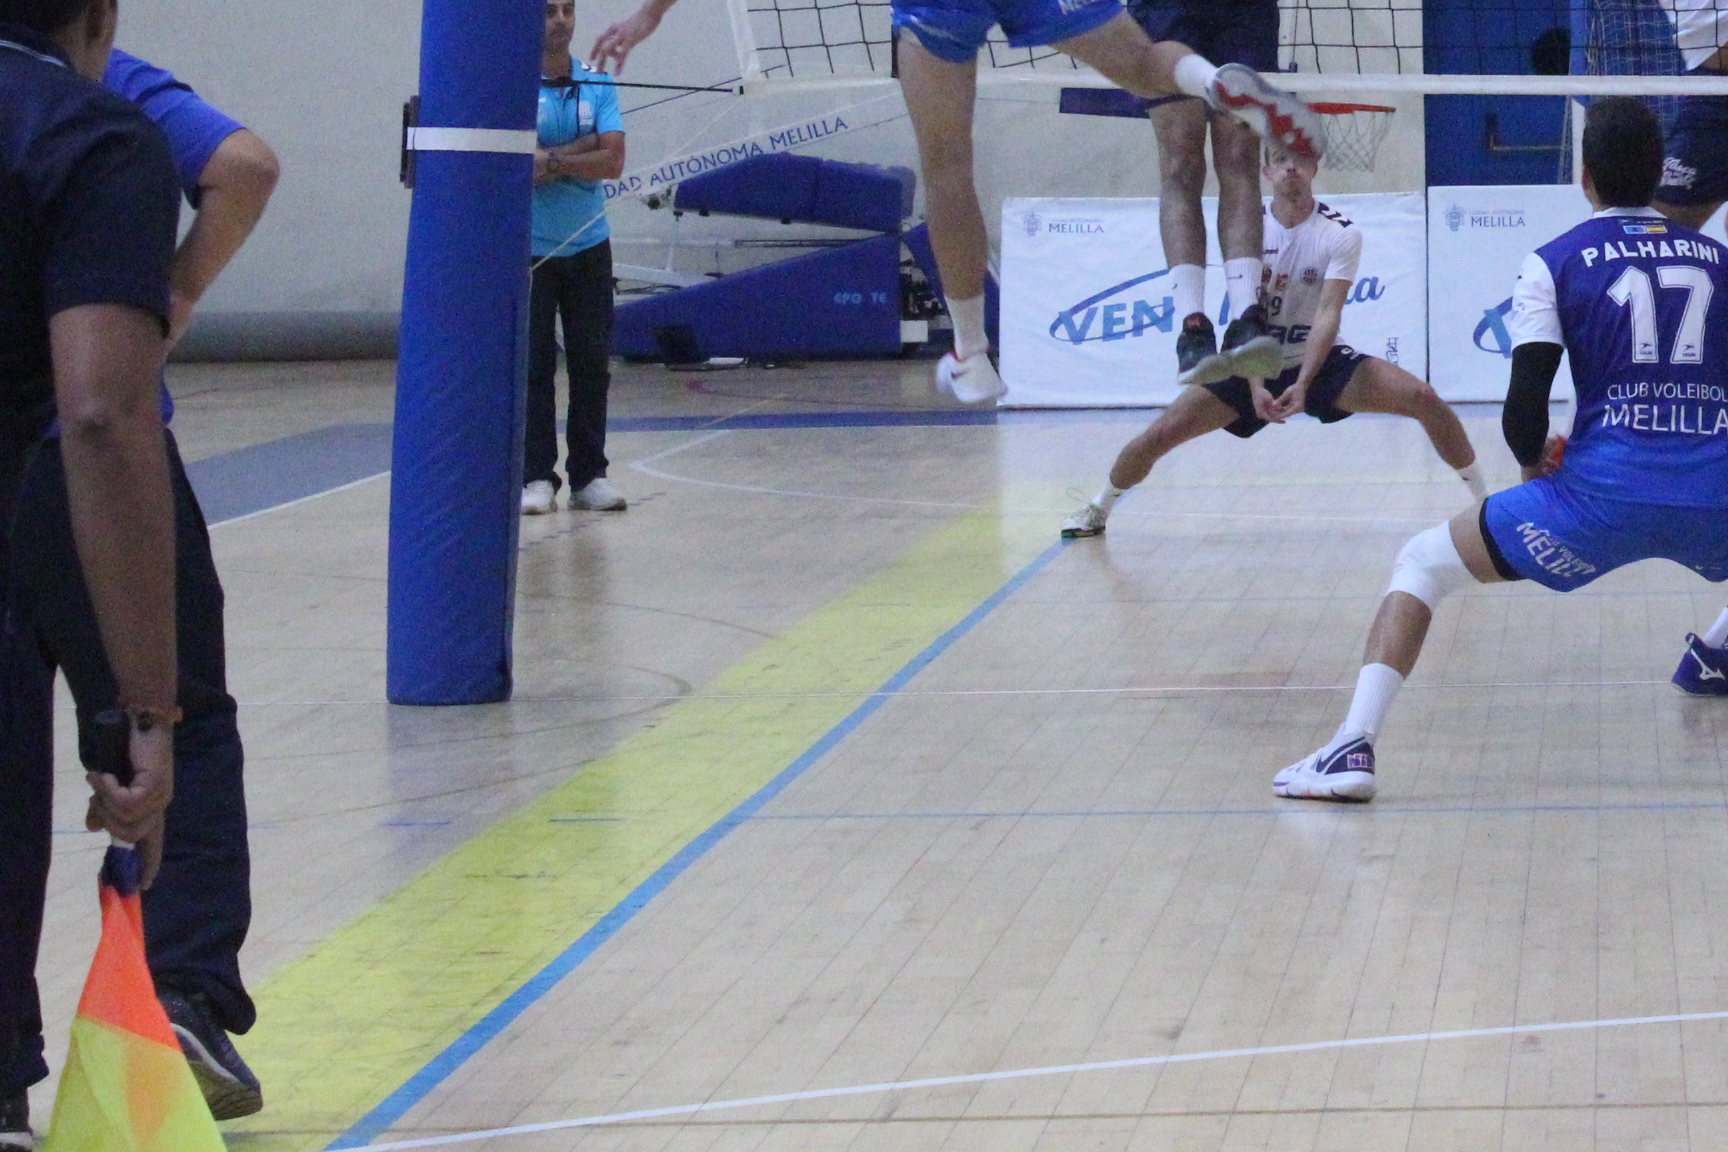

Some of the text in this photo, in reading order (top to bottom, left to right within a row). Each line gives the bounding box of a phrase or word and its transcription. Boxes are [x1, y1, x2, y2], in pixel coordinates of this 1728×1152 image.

[650, 141, 764, 187] AUTÓNOMA
[769, 116, 848, 150] MELILLA
[1048, 223, 1104, 233] MELILLA
[1471, 216, 1526, 227] MELILLA
[1581, 239, 1720, 267] PALHARINI
[1058, 295, 1175, 345] VEN
[1606, 265, 1714, 364] 17
[1607, 382, 1728, 403] CLUB VOLEIBOL
